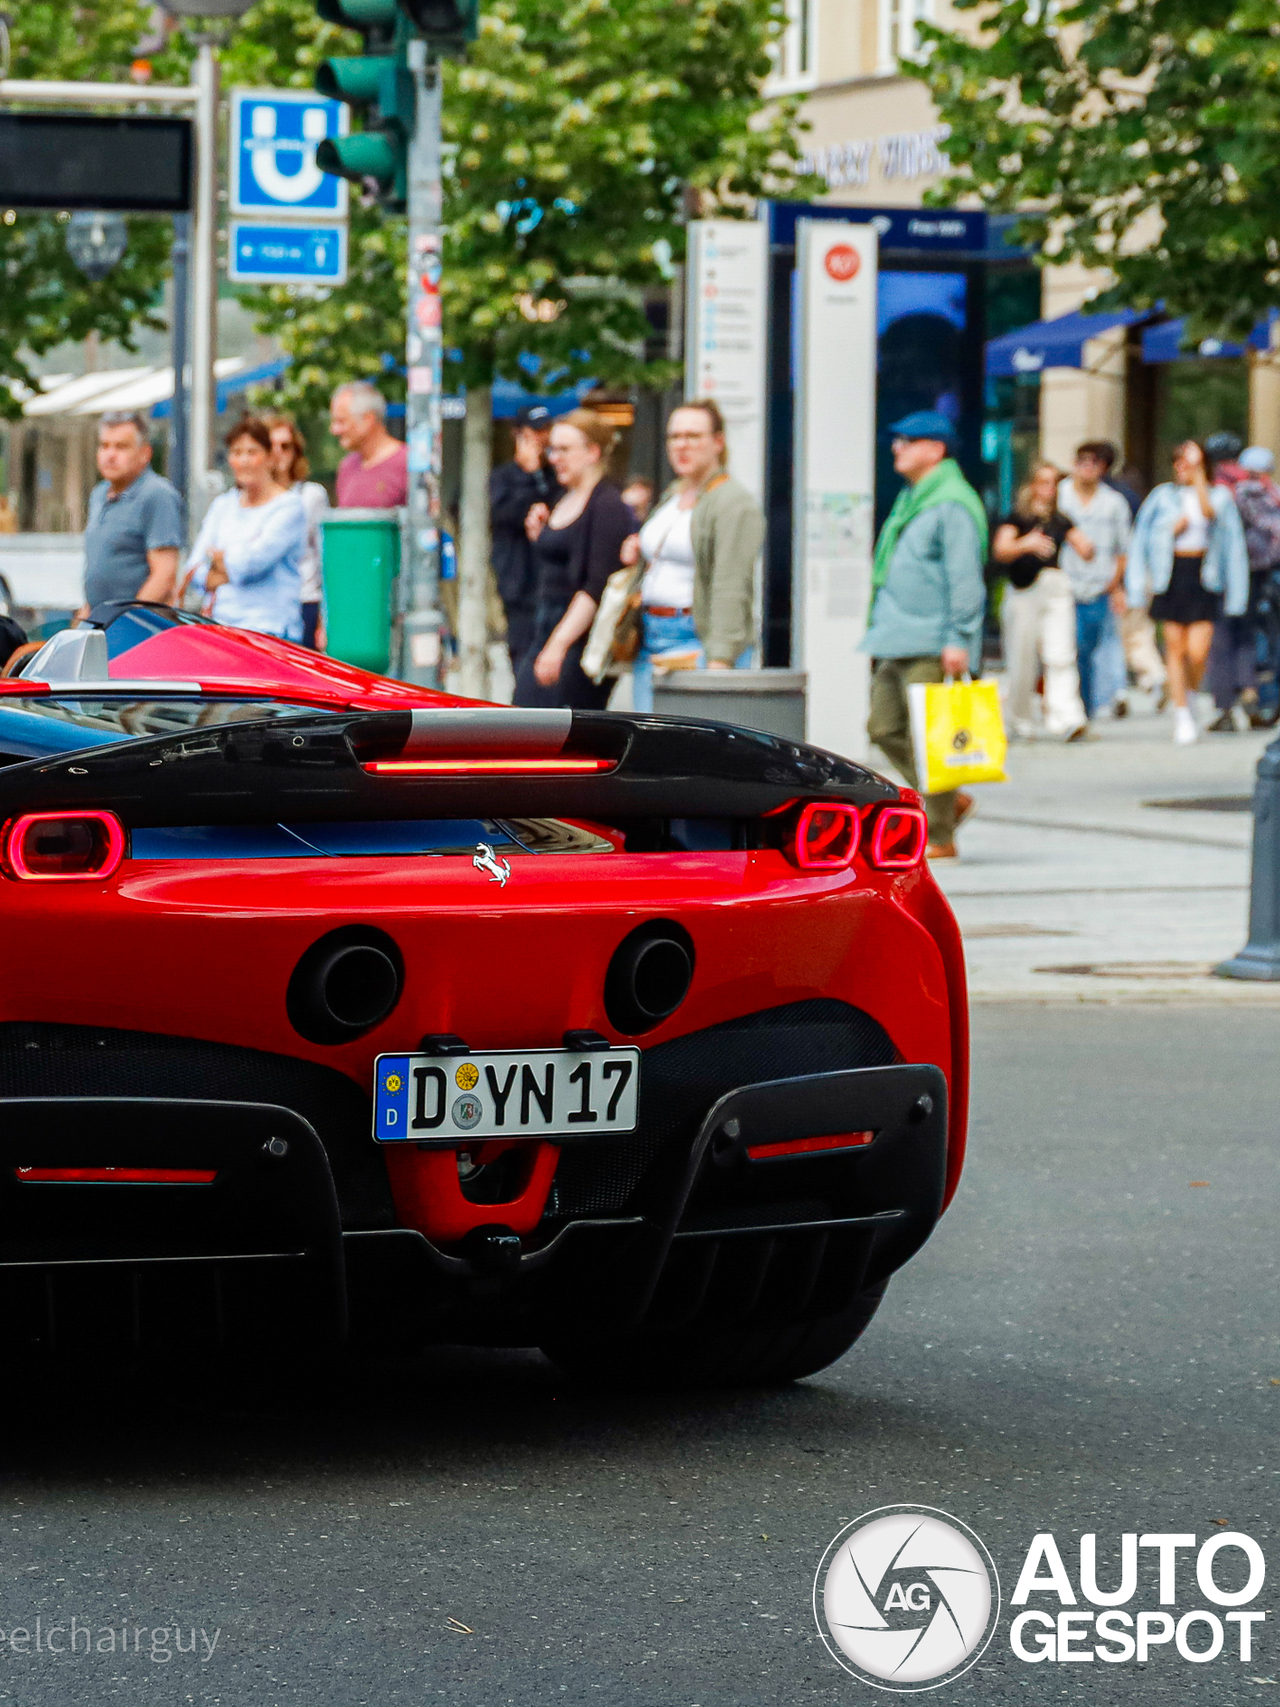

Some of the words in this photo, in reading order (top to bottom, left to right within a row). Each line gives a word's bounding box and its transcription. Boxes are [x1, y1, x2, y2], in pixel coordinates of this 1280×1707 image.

[251, 106, 327, 203] U
[386, 1108, 398, 1126] D
[412, 1066, 448, 1129] D
[484, 1063, 555, 1126] YN
[567, 1060, 633, 1123] 17
